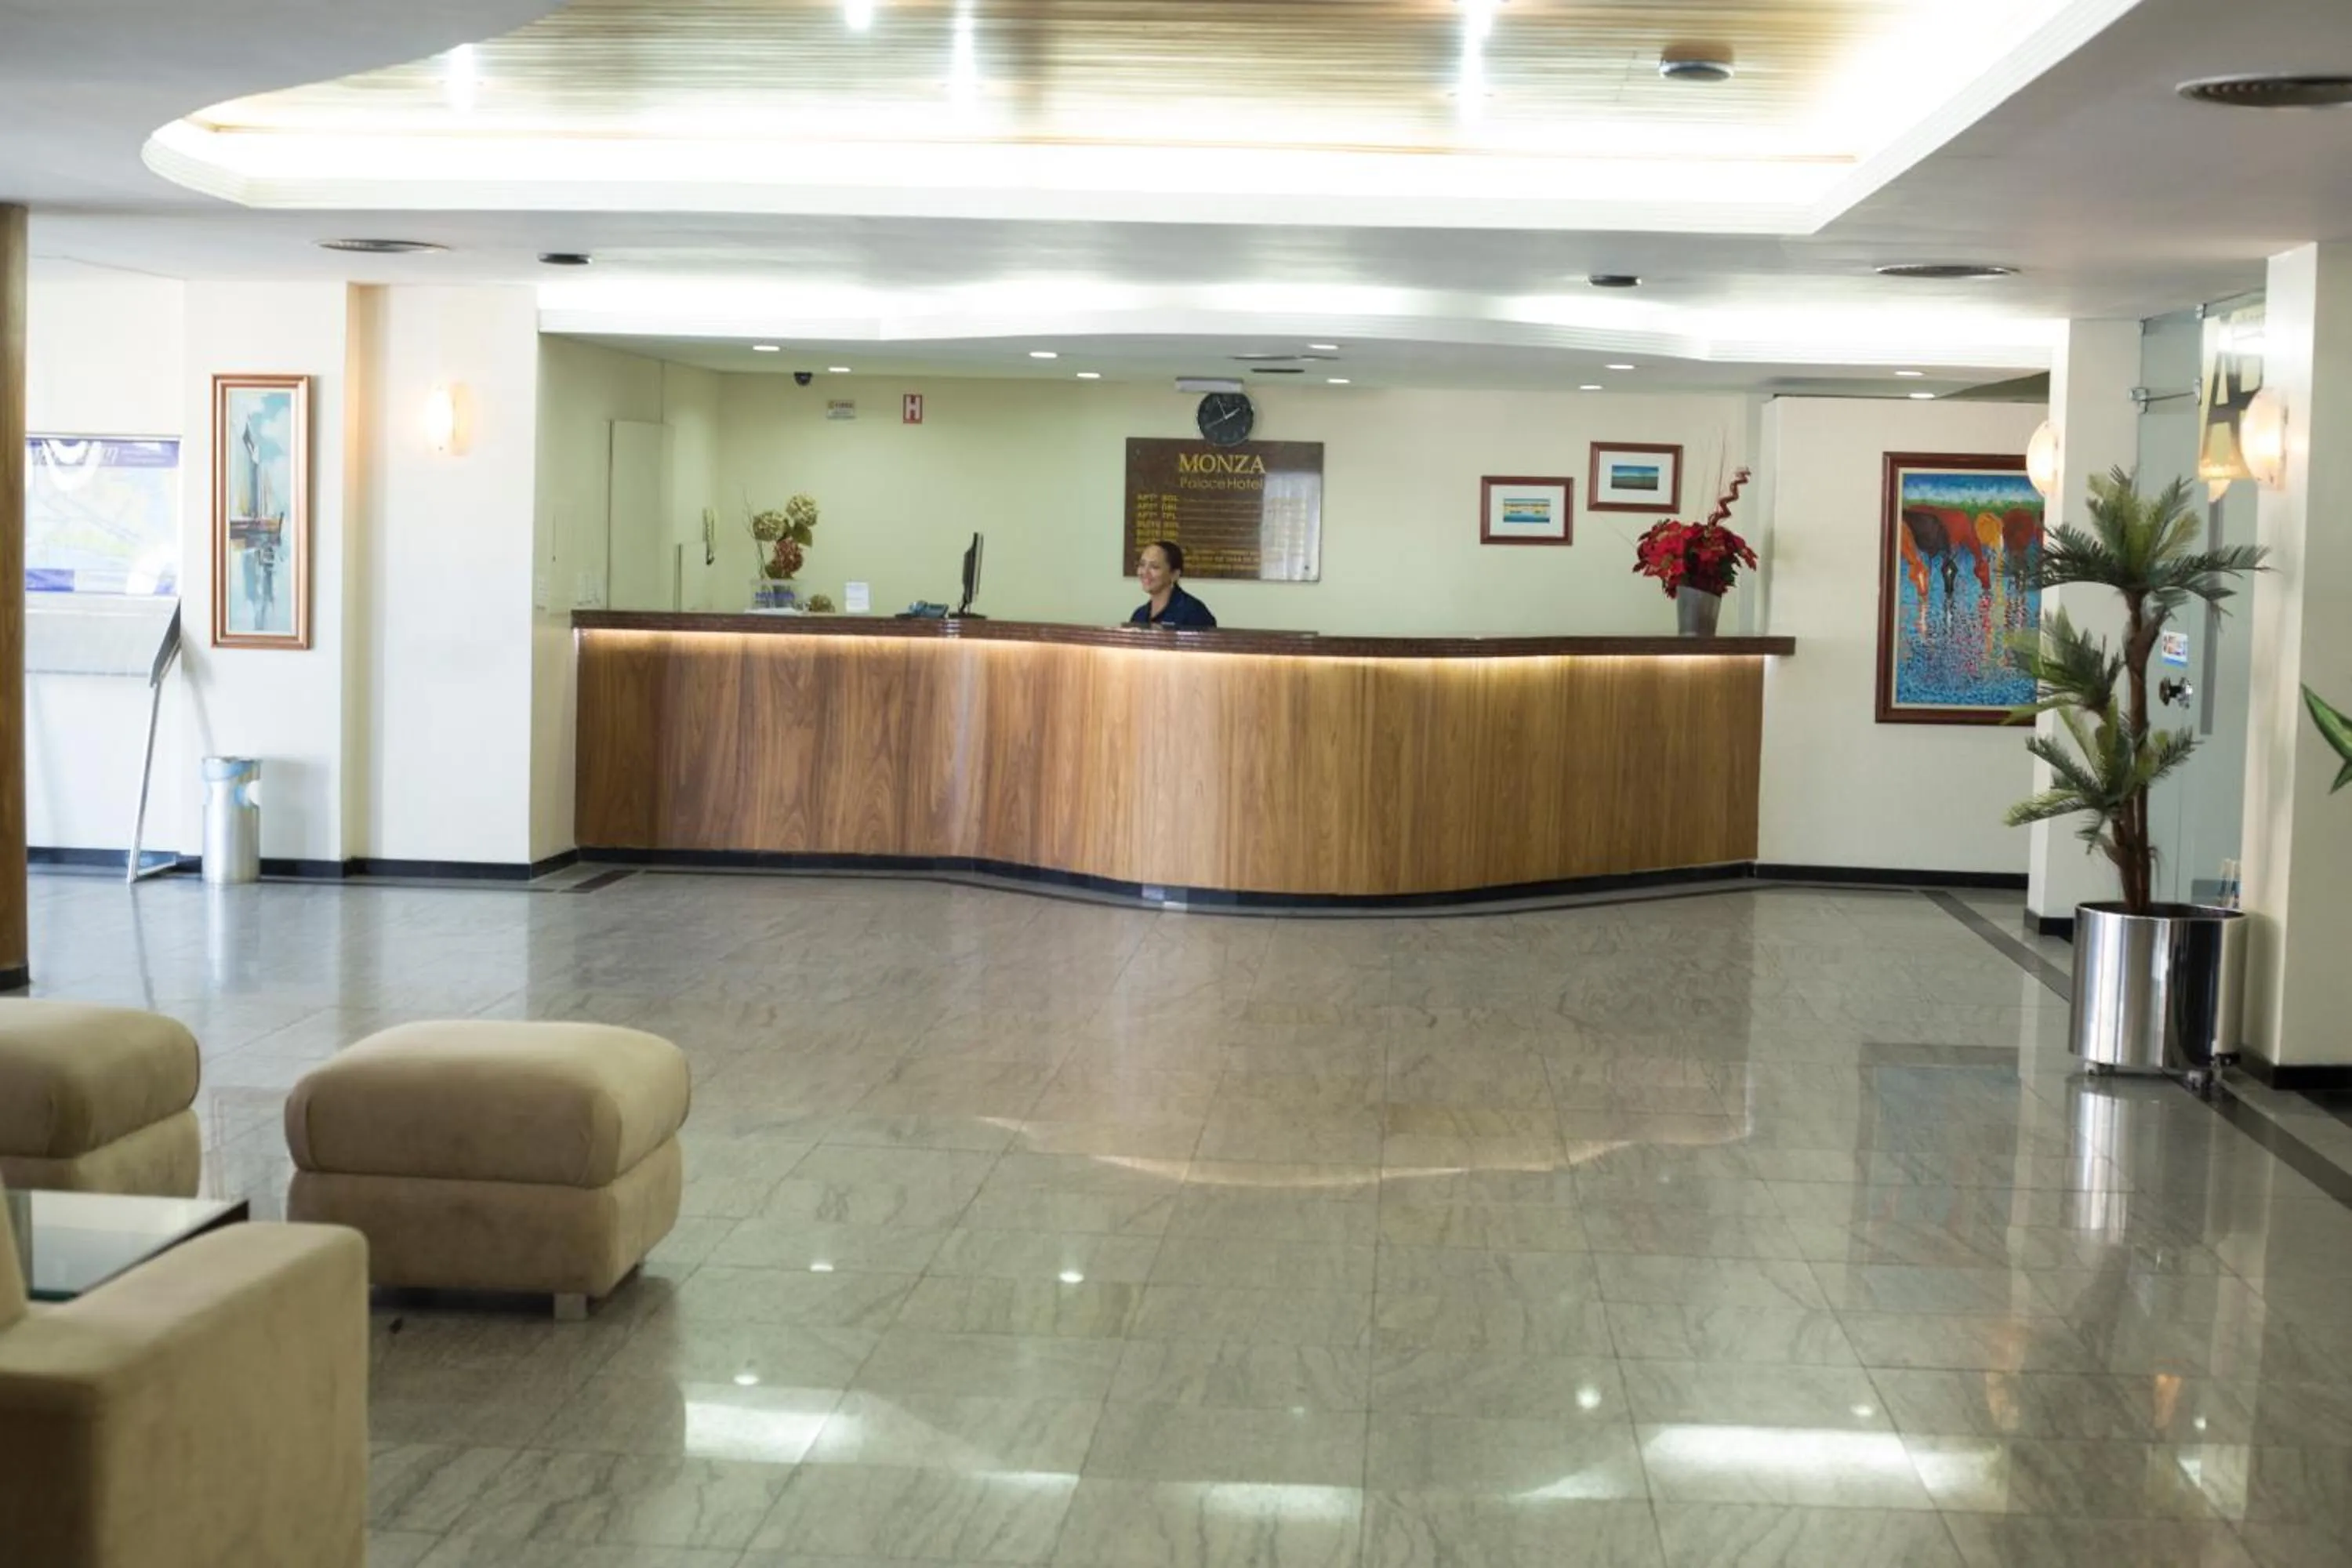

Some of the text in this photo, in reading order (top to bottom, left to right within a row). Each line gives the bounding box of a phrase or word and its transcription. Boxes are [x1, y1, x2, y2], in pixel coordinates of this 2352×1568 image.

[1178, 453, 1267, 474] MONZA
[1180, 477, 1263, 490] Palace Hotel
